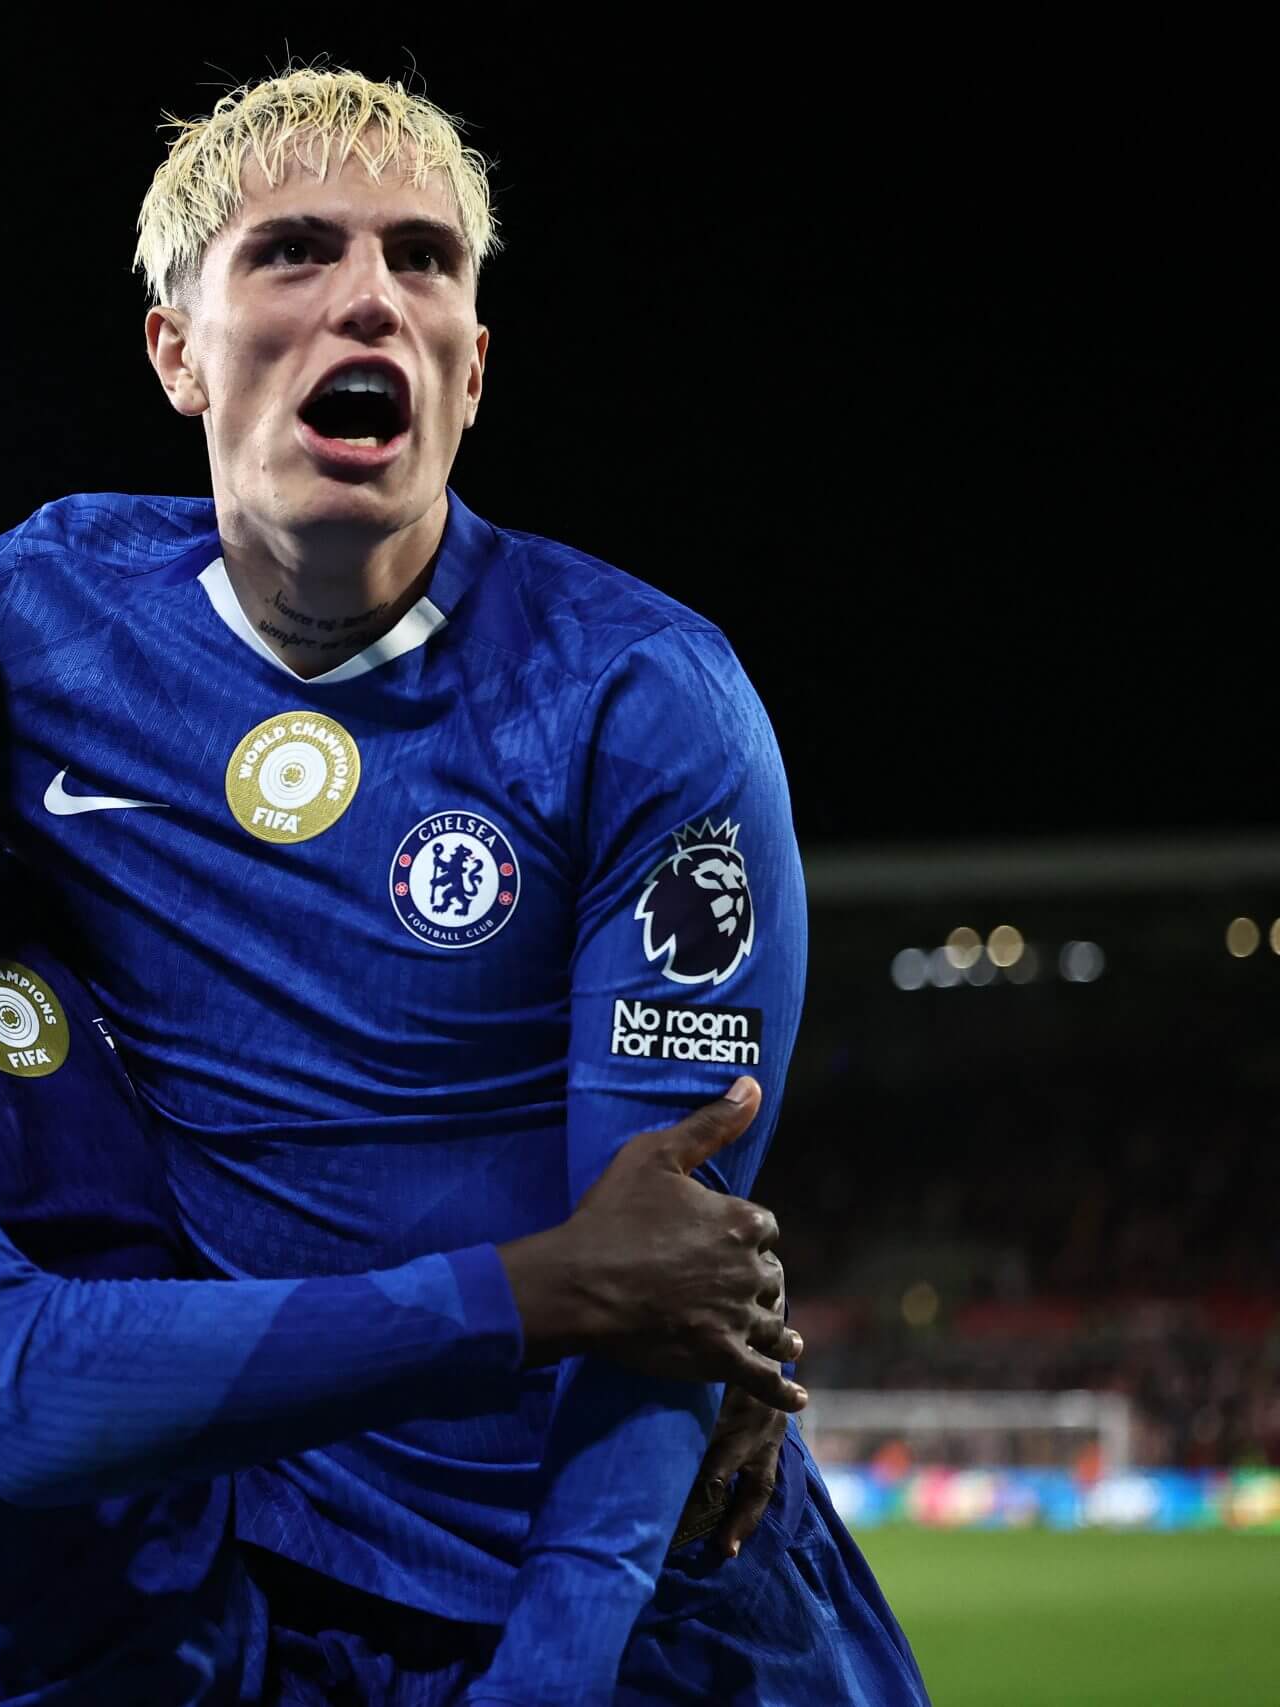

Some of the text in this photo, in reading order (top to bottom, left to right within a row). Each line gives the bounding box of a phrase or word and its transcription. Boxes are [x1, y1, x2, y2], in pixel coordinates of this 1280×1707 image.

[239, 722, 348, 800] WORLD CHAMPIONS
[251, 806, 299, 833] FIFA
[418, 816, 497, 848] CHELSEA
[408, 913, 494, 940] FOOTBALL CLUB
[613, 999, 748, 1038] No room
[7, 1051, 51, 1068] FIFA
[611, 1026, 760, 1065] for racism
